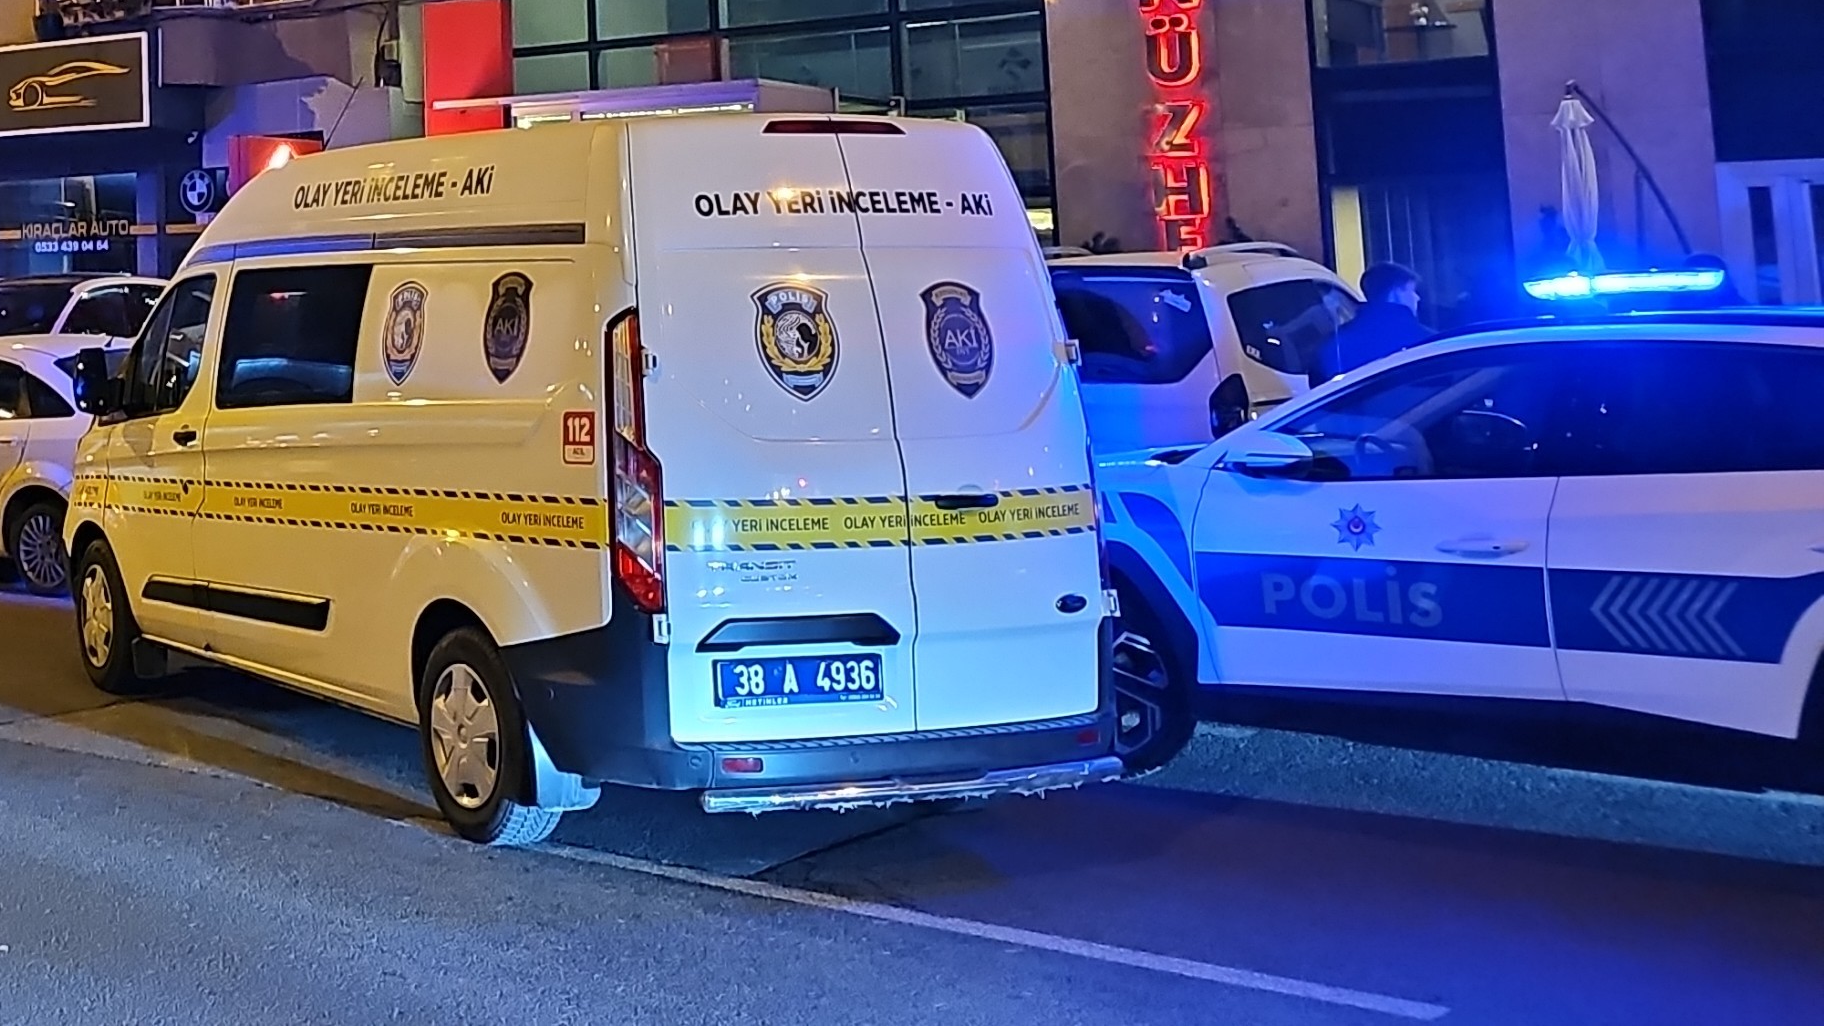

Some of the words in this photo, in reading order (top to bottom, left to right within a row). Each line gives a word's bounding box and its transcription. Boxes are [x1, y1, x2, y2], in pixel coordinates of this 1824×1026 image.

[294, 181, 333, 209] OLAY
[694, 192, 760, 217] OLAY
[90, 220, 129, 236] AUTO
[566, 416, 591, 442] 112
[501, 511, 523, 525] OLAY
[844, 516, 876, 529] OLAY
[978, 508, 1007, 524] OLAY
[1261, 565, 1443, 627] POLİS
[733, 664, 765, 695] 38
[783, 663, 799, 693] A
[816, 659, 876, 691] 4936
